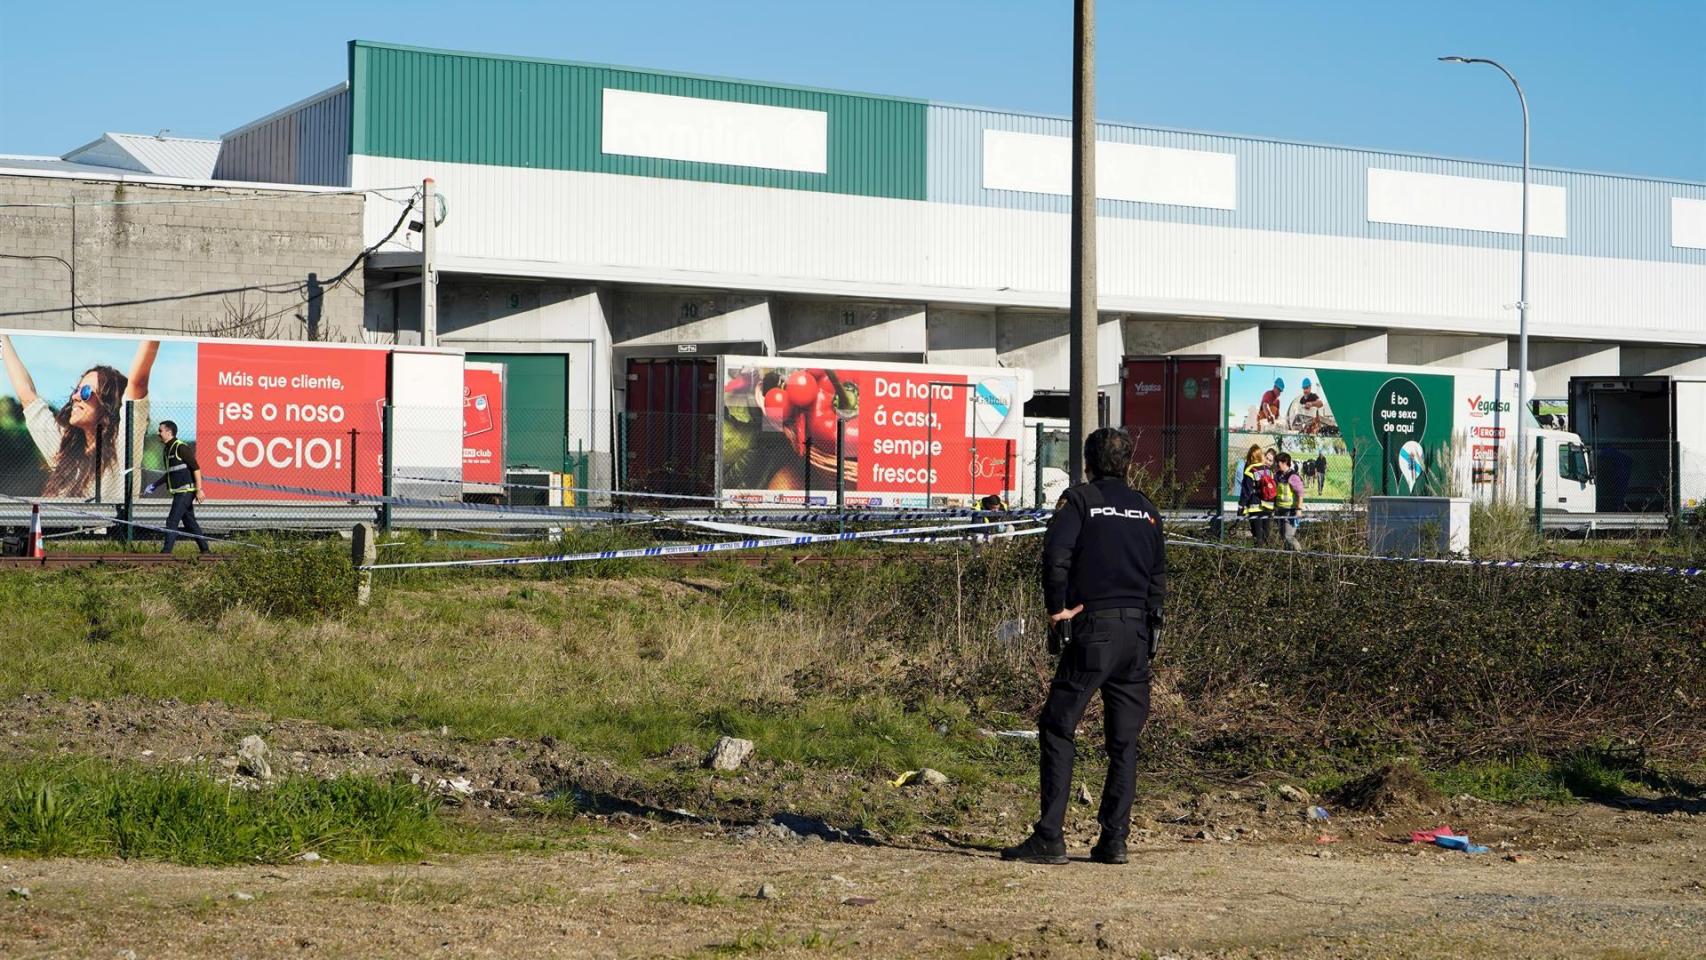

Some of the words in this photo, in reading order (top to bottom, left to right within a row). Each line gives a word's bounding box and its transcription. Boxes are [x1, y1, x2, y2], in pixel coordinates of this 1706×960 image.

[511, 294, 519, 308] 9
[681, 303, 698, 318] 10
[842, 311, 855, 325] 11
[218, 371, 253, 387] Máis
[258, 377, 287, 391] que
[291, 374, 345, 391] cliente,
[874, 378, 902, 397] Da
[1391, 392, 1396, 404] É
[1397, 395, 1409, 405] bo
[1467, 395, 1511, 415] Vegalsa
[218, 403, 253, 423] ¡es
[261, 405, 277, 421] o
[285, 404, 345, 423] noso
[874, 407, 886, 426] á
[892, 410, 942, 430] casa,
[1381, 409, 1397, 419] que
[1398, 410, 1418, 419] sexa
[1383, 422, 1395, 432] de
[1396, 422, 1415, 434] aquí
[216, 436, 342, 470] SOCIO!
[873, 440, 942, 458] sempre
[872, 463, 937, 484] frescos
[1089, 506, 1151, 521] POLICIA
